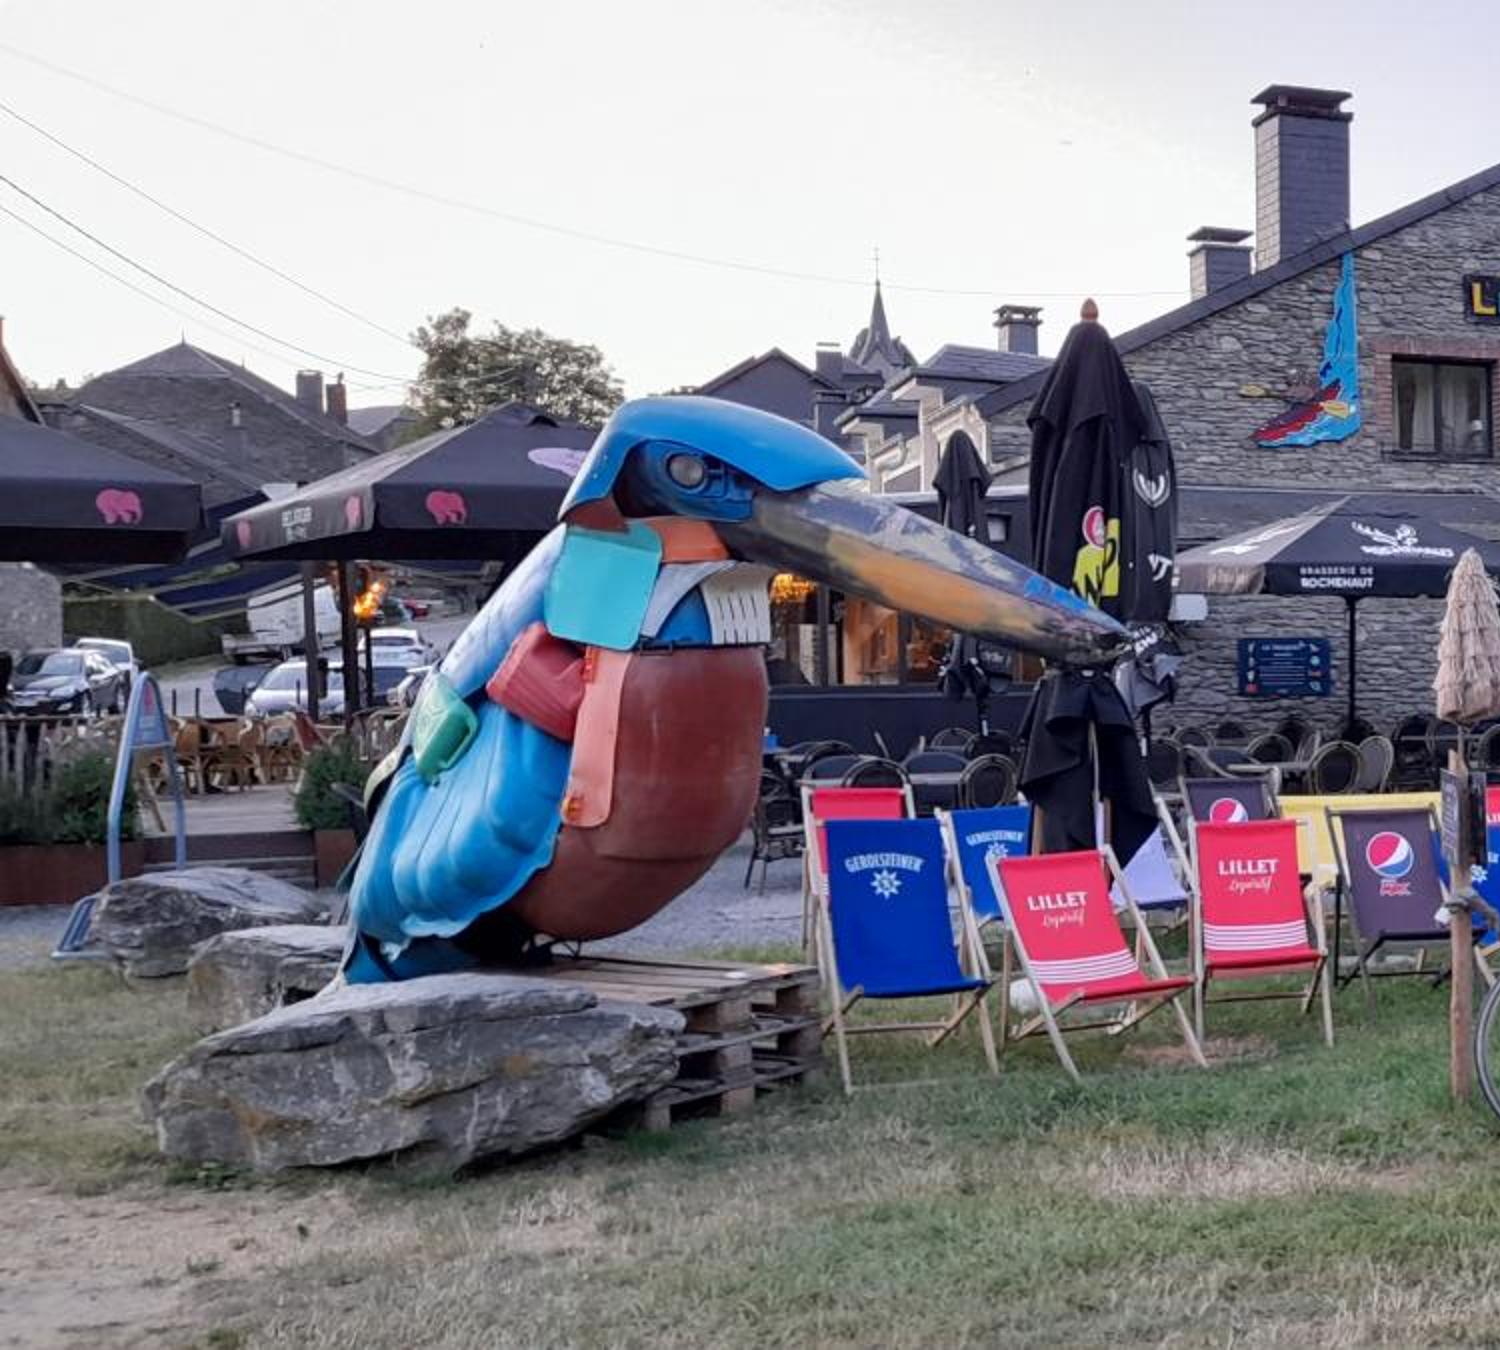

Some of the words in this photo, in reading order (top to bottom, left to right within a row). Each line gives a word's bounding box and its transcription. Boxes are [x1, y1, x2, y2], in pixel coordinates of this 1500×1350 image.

[1300, 566, 1351, 576] BRASSERIE
[1358, 567, 1374, 576] DE
[1300, 576, 1375, 589] ROCHEHAUT
[844, 852, 926, 873] GEROLSTEINER
[1218, 858, 1280, 876] LILLET
[1027, 890, 1089, 912] LILLET
